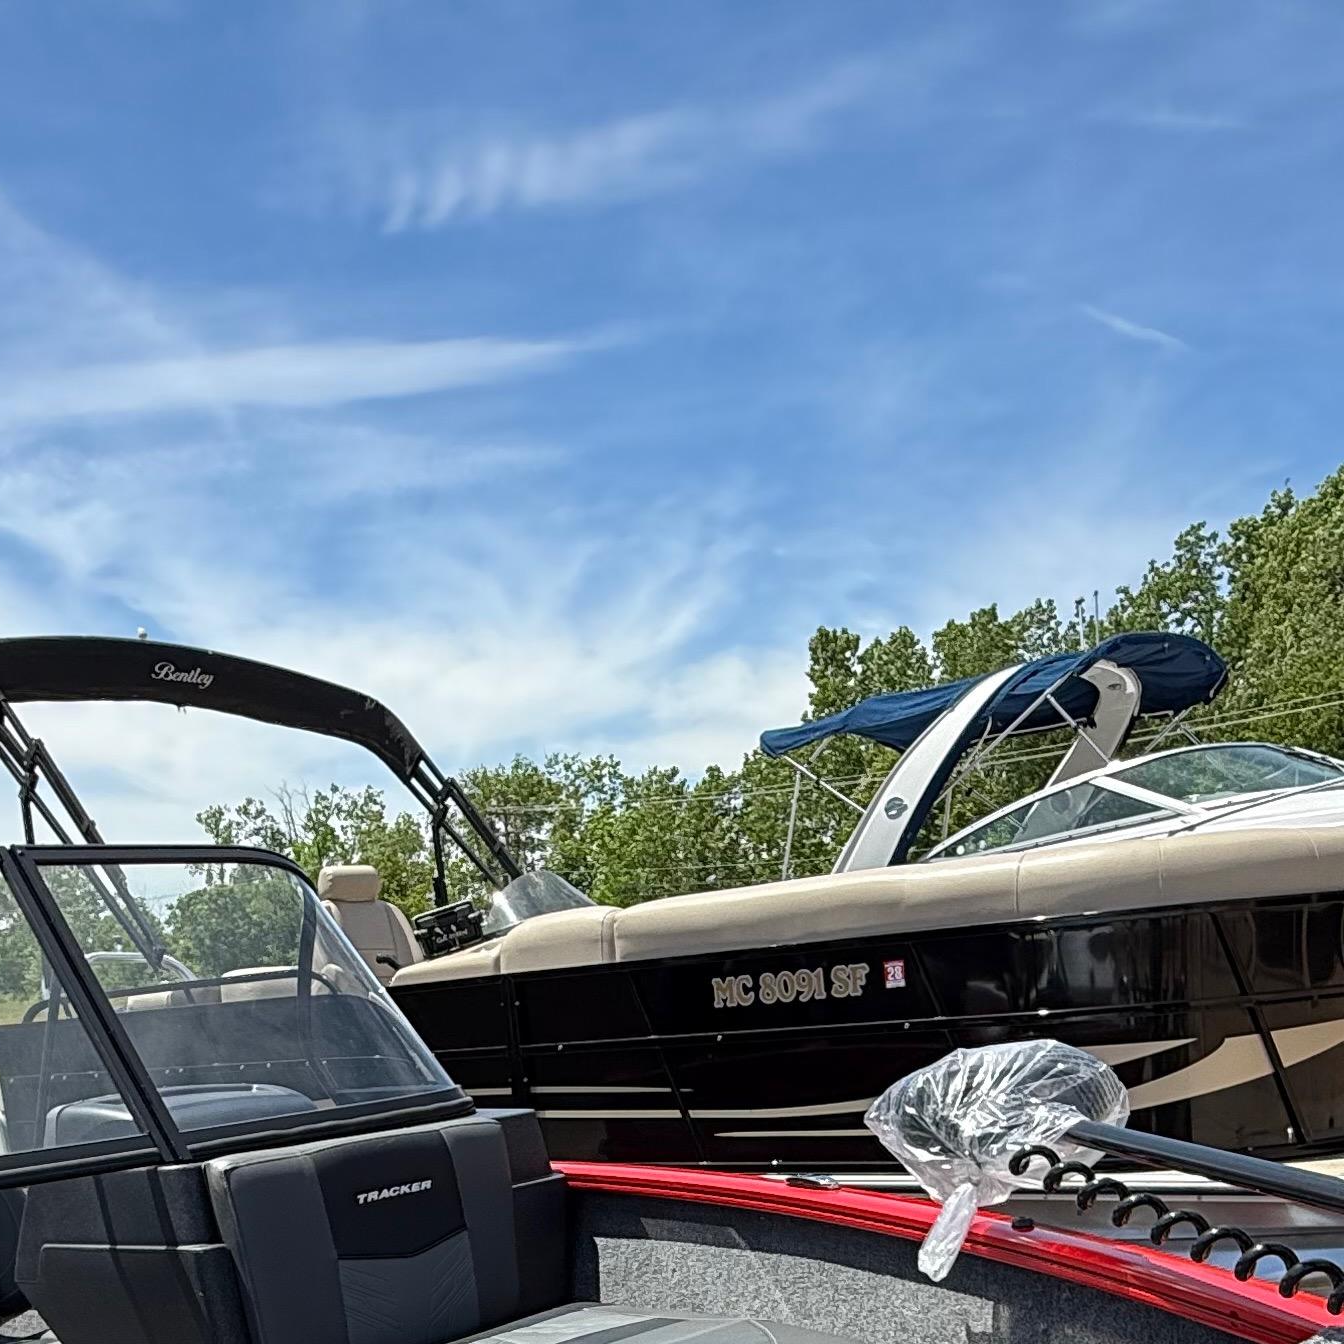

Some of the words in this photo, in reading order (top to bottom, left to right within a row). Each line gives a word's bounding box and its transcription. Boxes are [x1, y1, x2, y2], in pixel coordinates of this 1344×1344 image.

[151, 662, 214, 689] Bentley
[711, 975, 755, 1008] MC
[759, 967, 827, 1005] 8091
[830, 962, 870, 998] SF
[887, 966, 902, 980] 28
[356, 1180, 432, 1205] TRACKER
